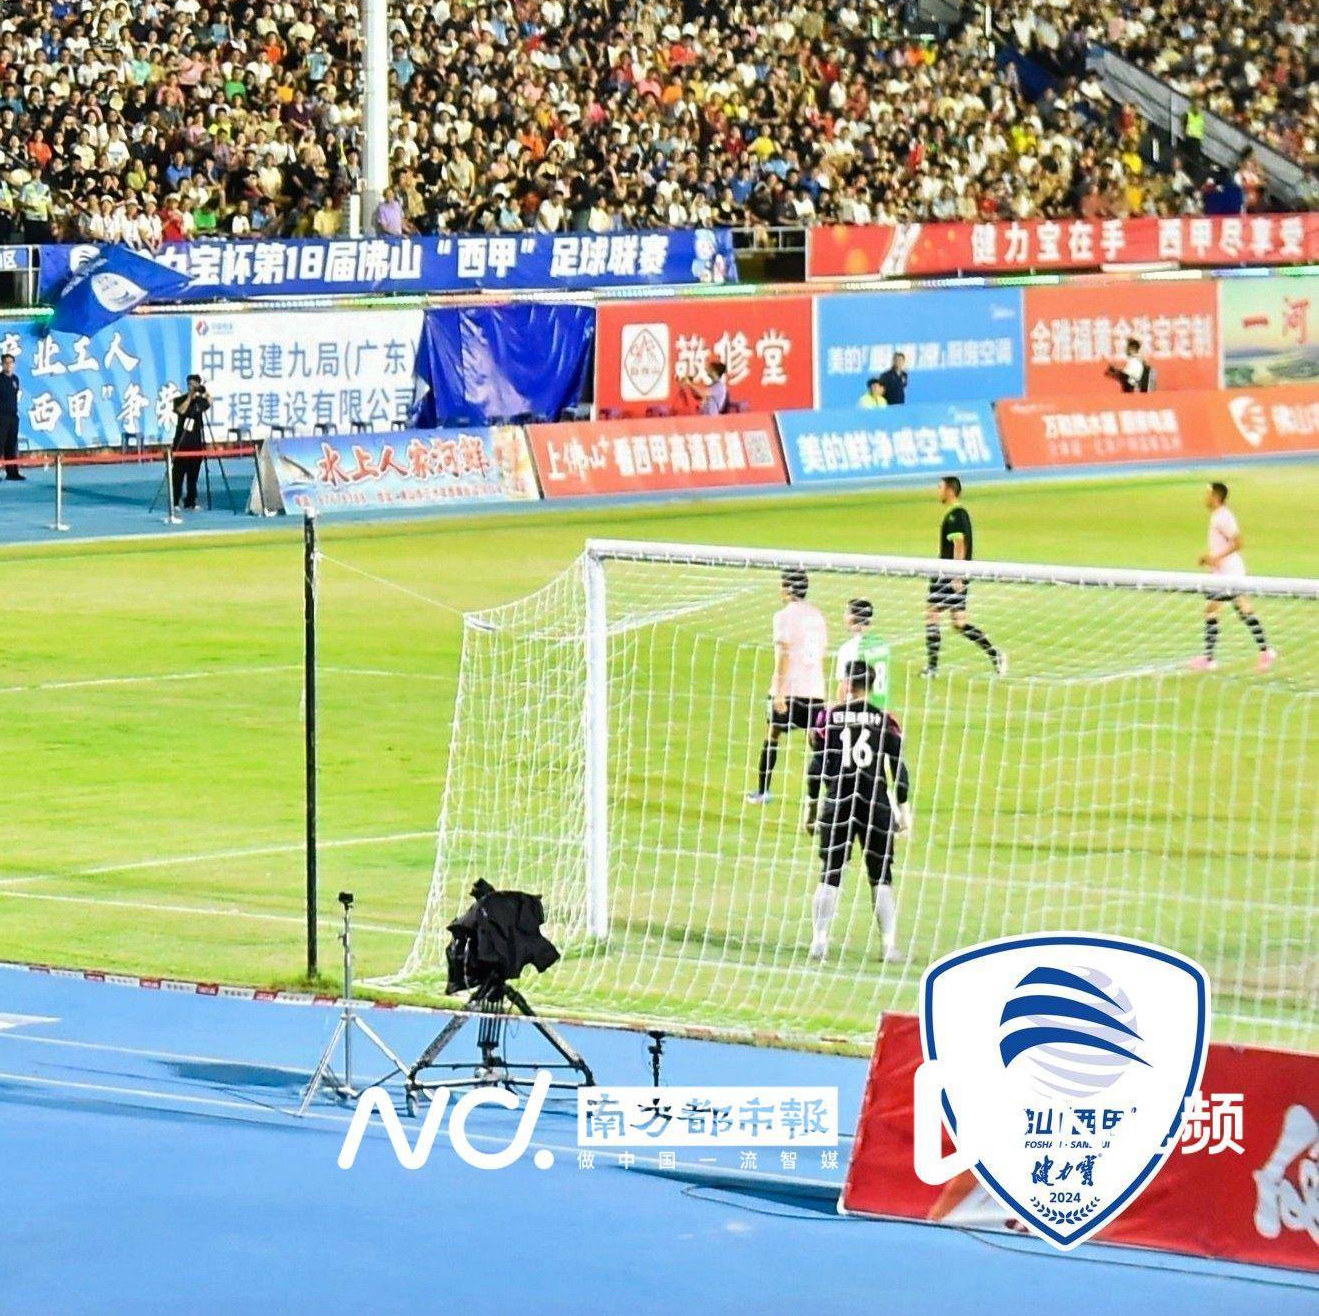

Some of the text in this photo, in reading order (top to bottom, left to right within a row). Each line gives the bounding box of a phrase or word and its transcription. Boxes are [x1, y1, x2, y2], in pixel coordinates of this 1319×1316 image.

[139, 234, 668, 286] 力宝杯第18届佛山“西甲”足球联赛
[971, 220, 1126, 266] 健力宝在手
[839, 727, 874, 769] 16
